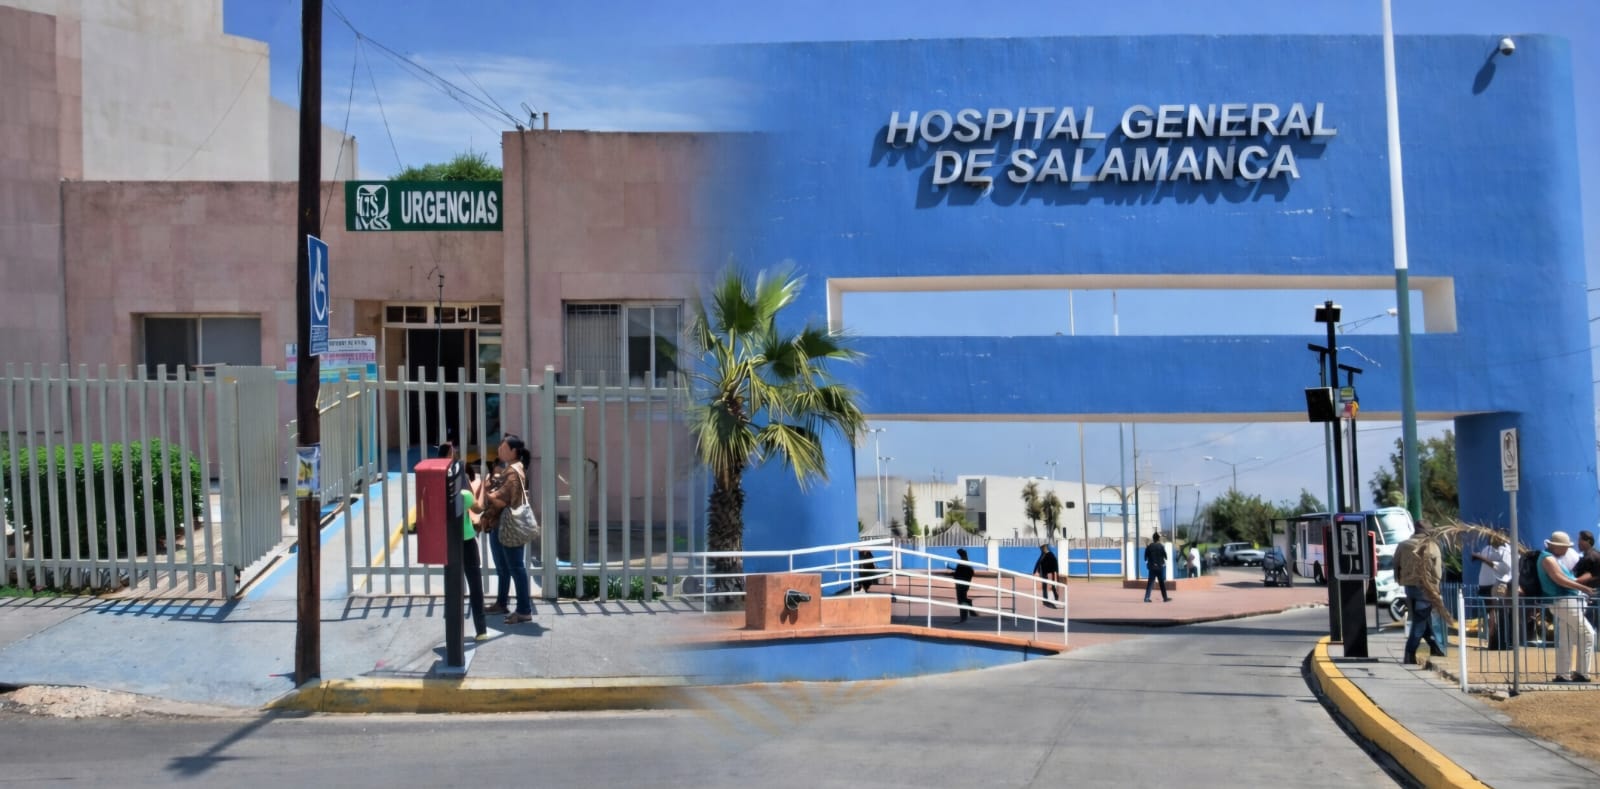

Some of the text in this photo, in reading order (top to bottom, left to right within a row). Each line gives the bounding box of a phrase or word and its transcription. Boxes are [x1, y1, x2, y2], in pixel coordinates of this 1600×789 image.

[886, 102, 1338, 144] HOSPITAL GENERAL
[932, 145, 1301, 184] DE SALAMANCA
[401, 191, 498, 224] URGENCIAS
